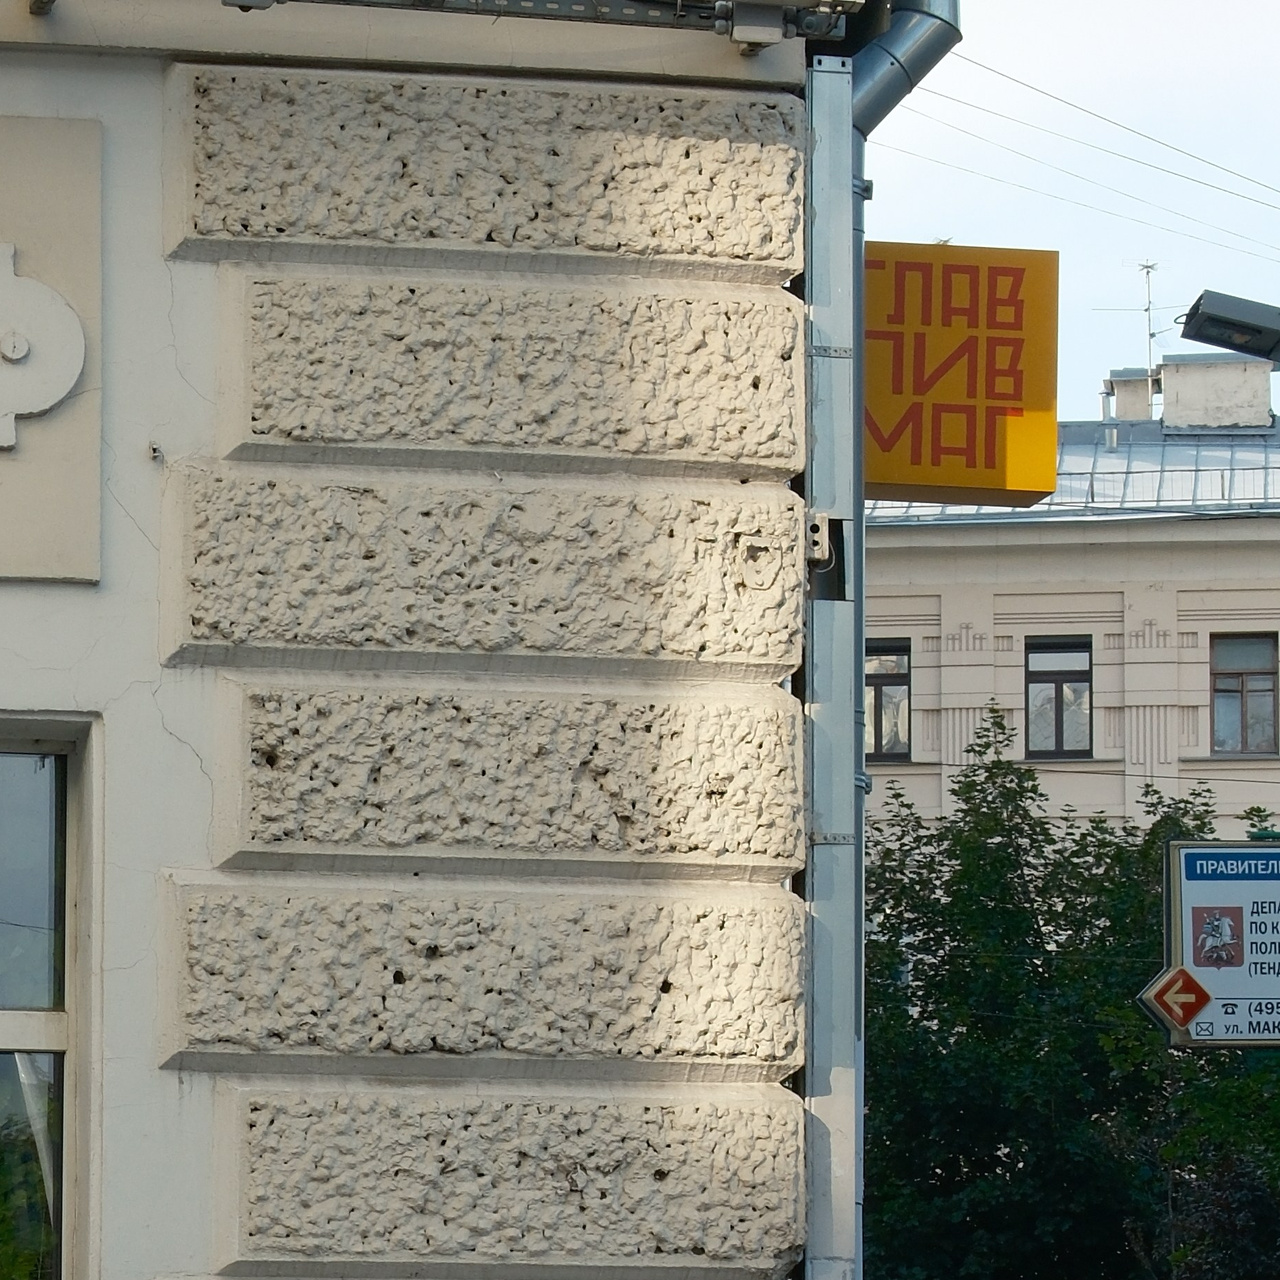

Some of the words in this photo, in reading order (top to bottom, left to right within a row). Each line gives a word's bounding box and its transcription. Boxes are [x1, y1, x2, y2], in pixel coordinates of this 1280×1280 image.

[865, 260, 1026, 331] ЛАВ
[1196, 859, 1280, 875] ПРАВИТЕЛ
[1250, 921, 1268, 935] ПО
[1250, 941, 1280, 955] ПОЛ
[1224, 1023, 1244, 1035] ул.
